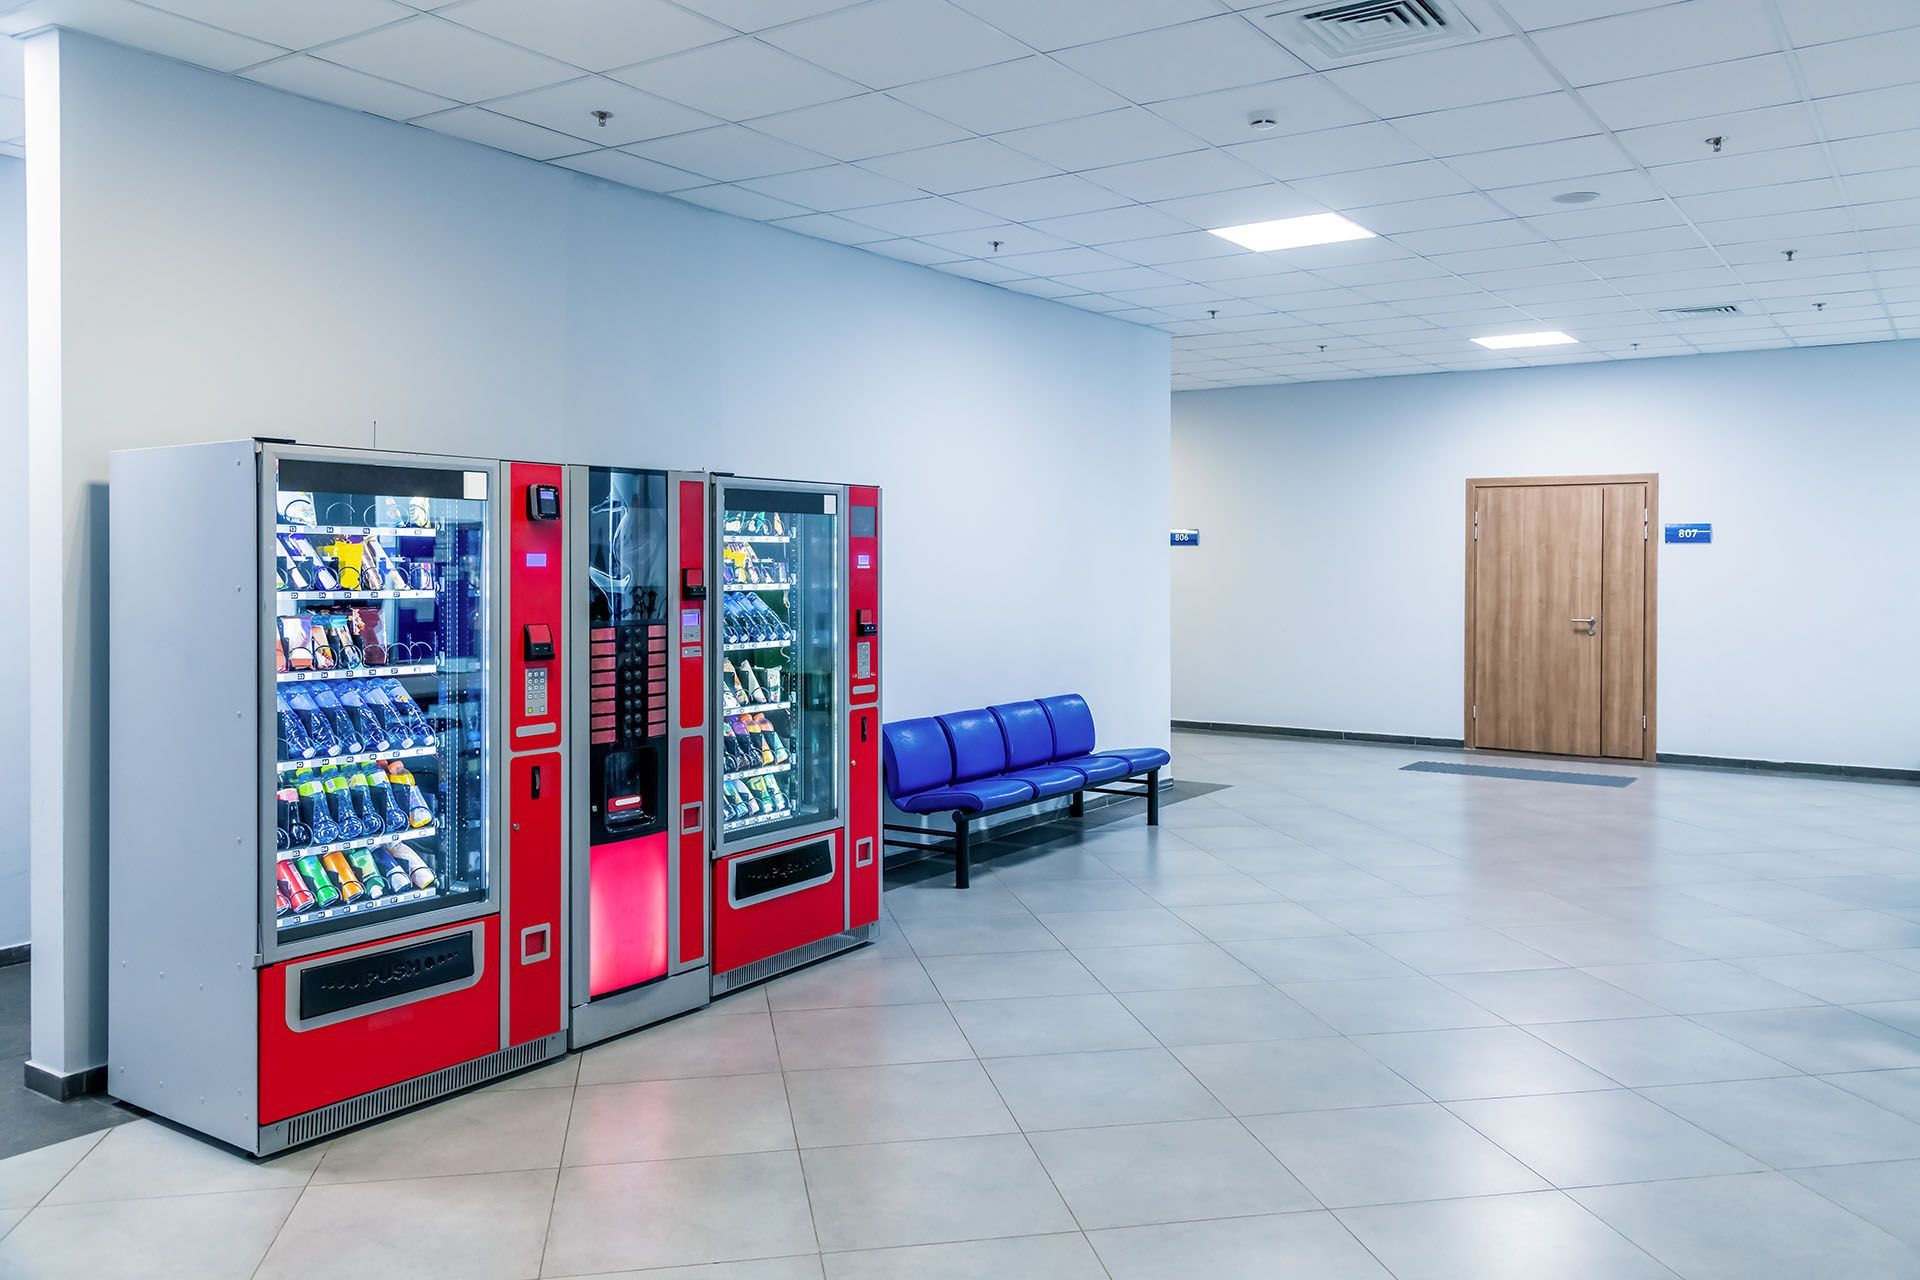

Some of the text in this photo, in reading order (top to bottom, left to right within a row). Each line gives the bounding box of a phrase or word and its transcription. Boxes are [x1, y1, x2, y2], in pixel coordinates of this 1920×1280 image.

[1174, 534, 1189, 542] 806
[1678, 529, 1698, 538] 807
[364, 958, 421, 987] PUSH
